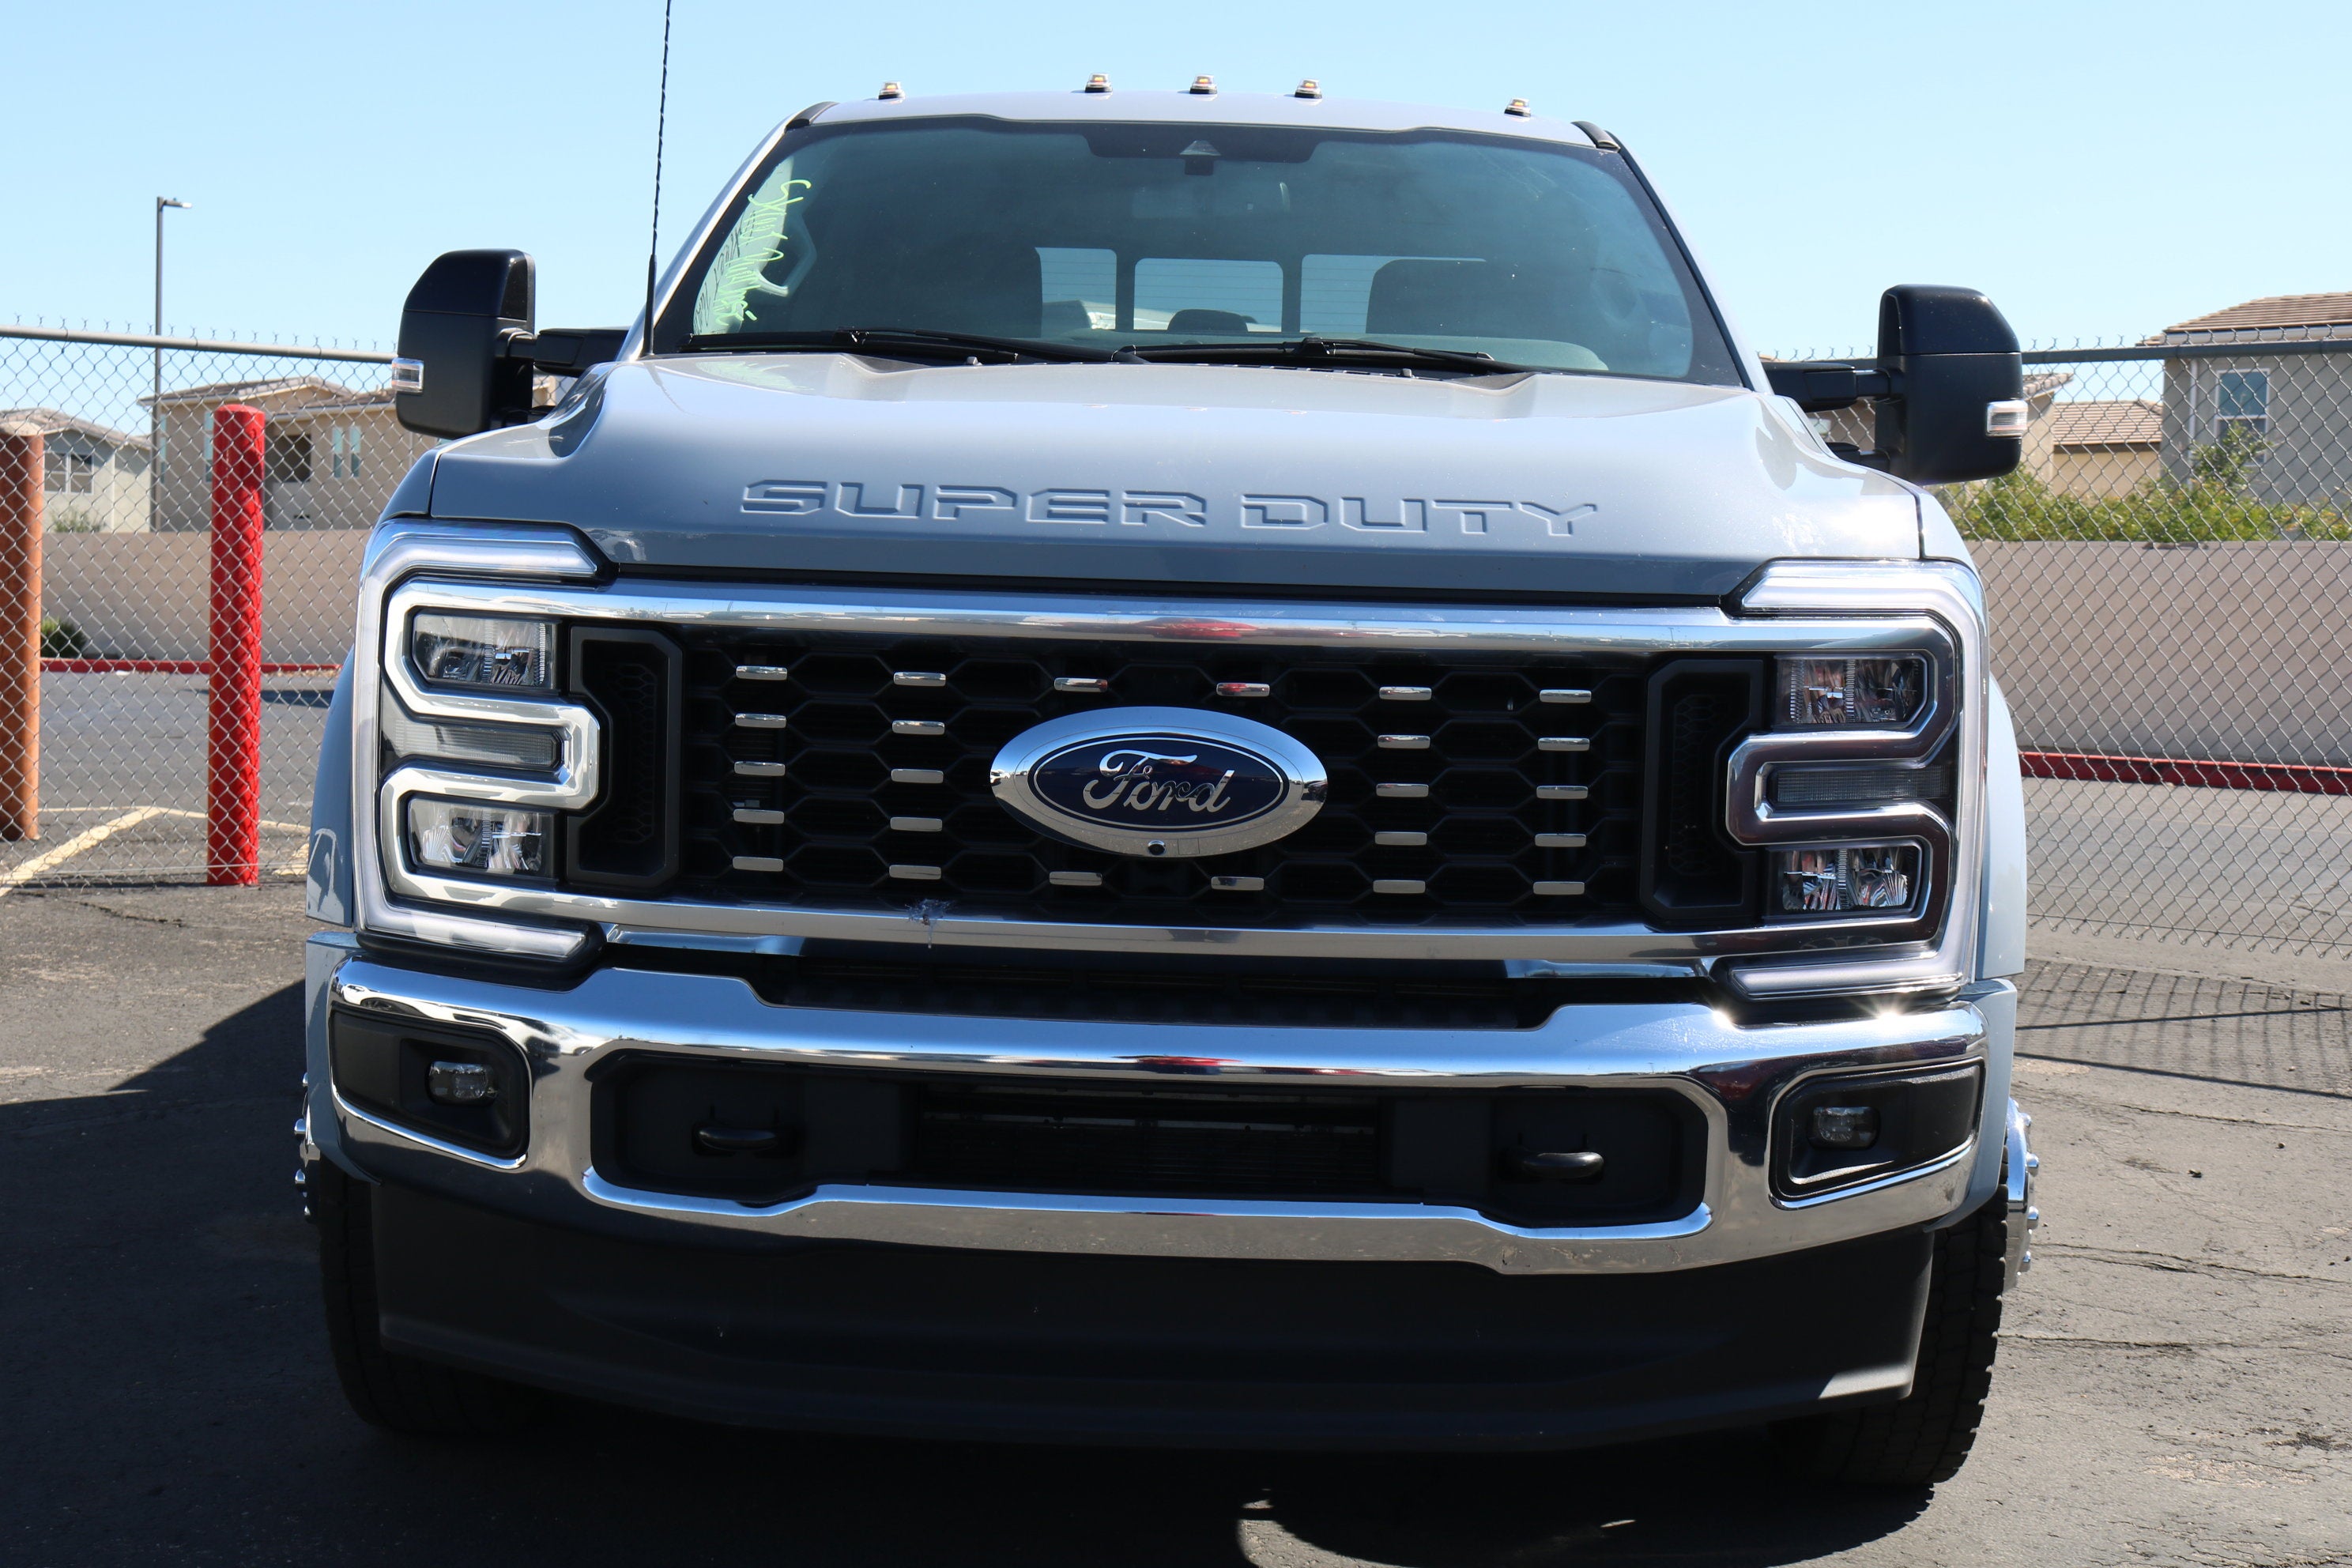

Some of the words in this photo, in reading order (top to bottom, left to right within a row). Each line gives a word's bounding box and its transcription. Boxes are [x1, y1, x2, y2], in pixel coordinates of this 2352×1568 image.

[741, 479, 1206, 526] SUPER
[1241, 493, 1597, 537] DUTY
[1083, 749, 1235, 813] Ford
